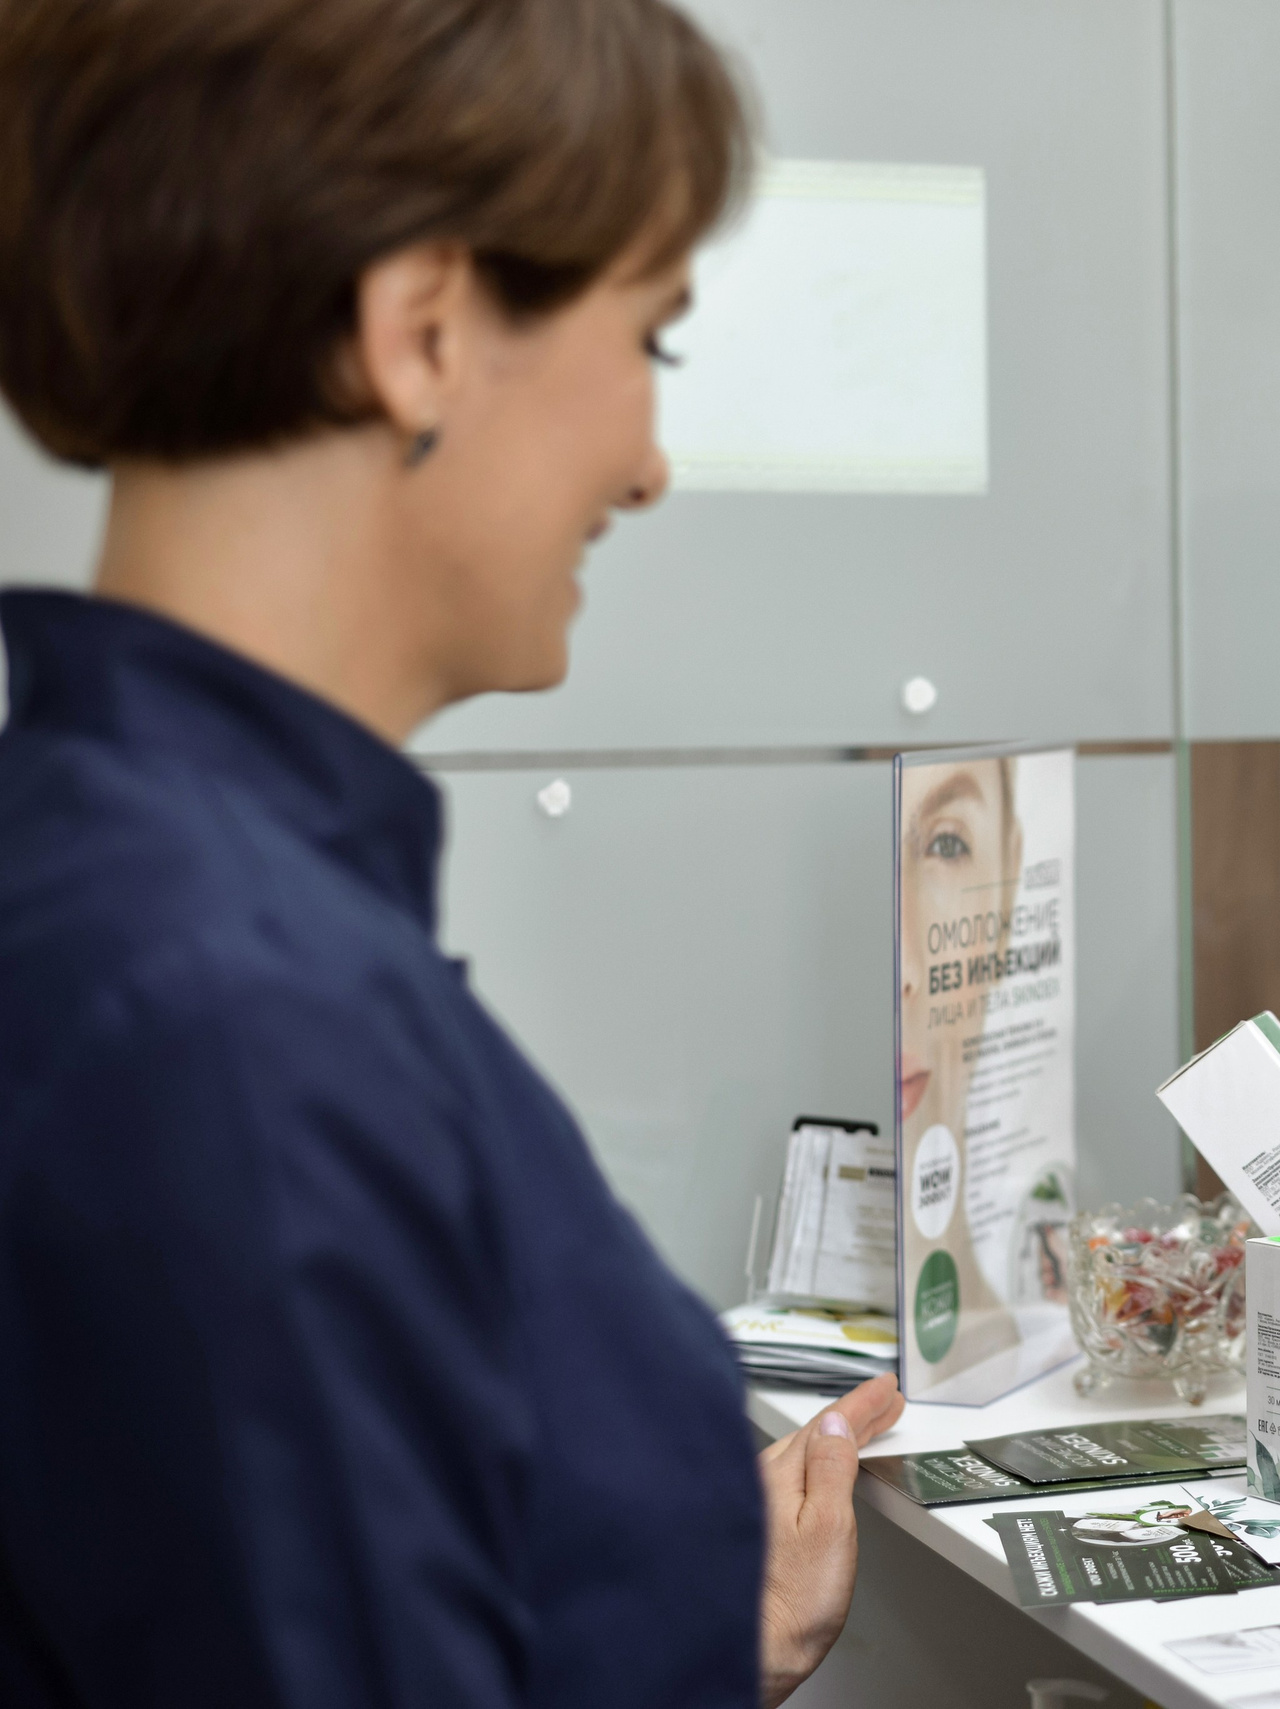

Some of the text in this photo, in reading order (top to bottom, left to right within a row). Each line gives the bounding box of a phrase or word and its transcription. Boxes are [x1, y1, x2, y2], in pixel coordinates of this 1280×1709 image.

[929, 960, 963, 995] БЕЗ
[1267, 1395, 1275, 1406] 30
[1054, 1432, 1128, 1466] SKINDEX
[947, 1455, 1021, 1487] SKINDEX
[1016, 1518, 1036, 1532] НЕТ!
[1021, 1532, 1049, 1571] ИНЪЕКЦИЯМ
[1169, 1544, 1202, 1564] 500
[1034, 1571, 1059, 1597] СКАЖИ
